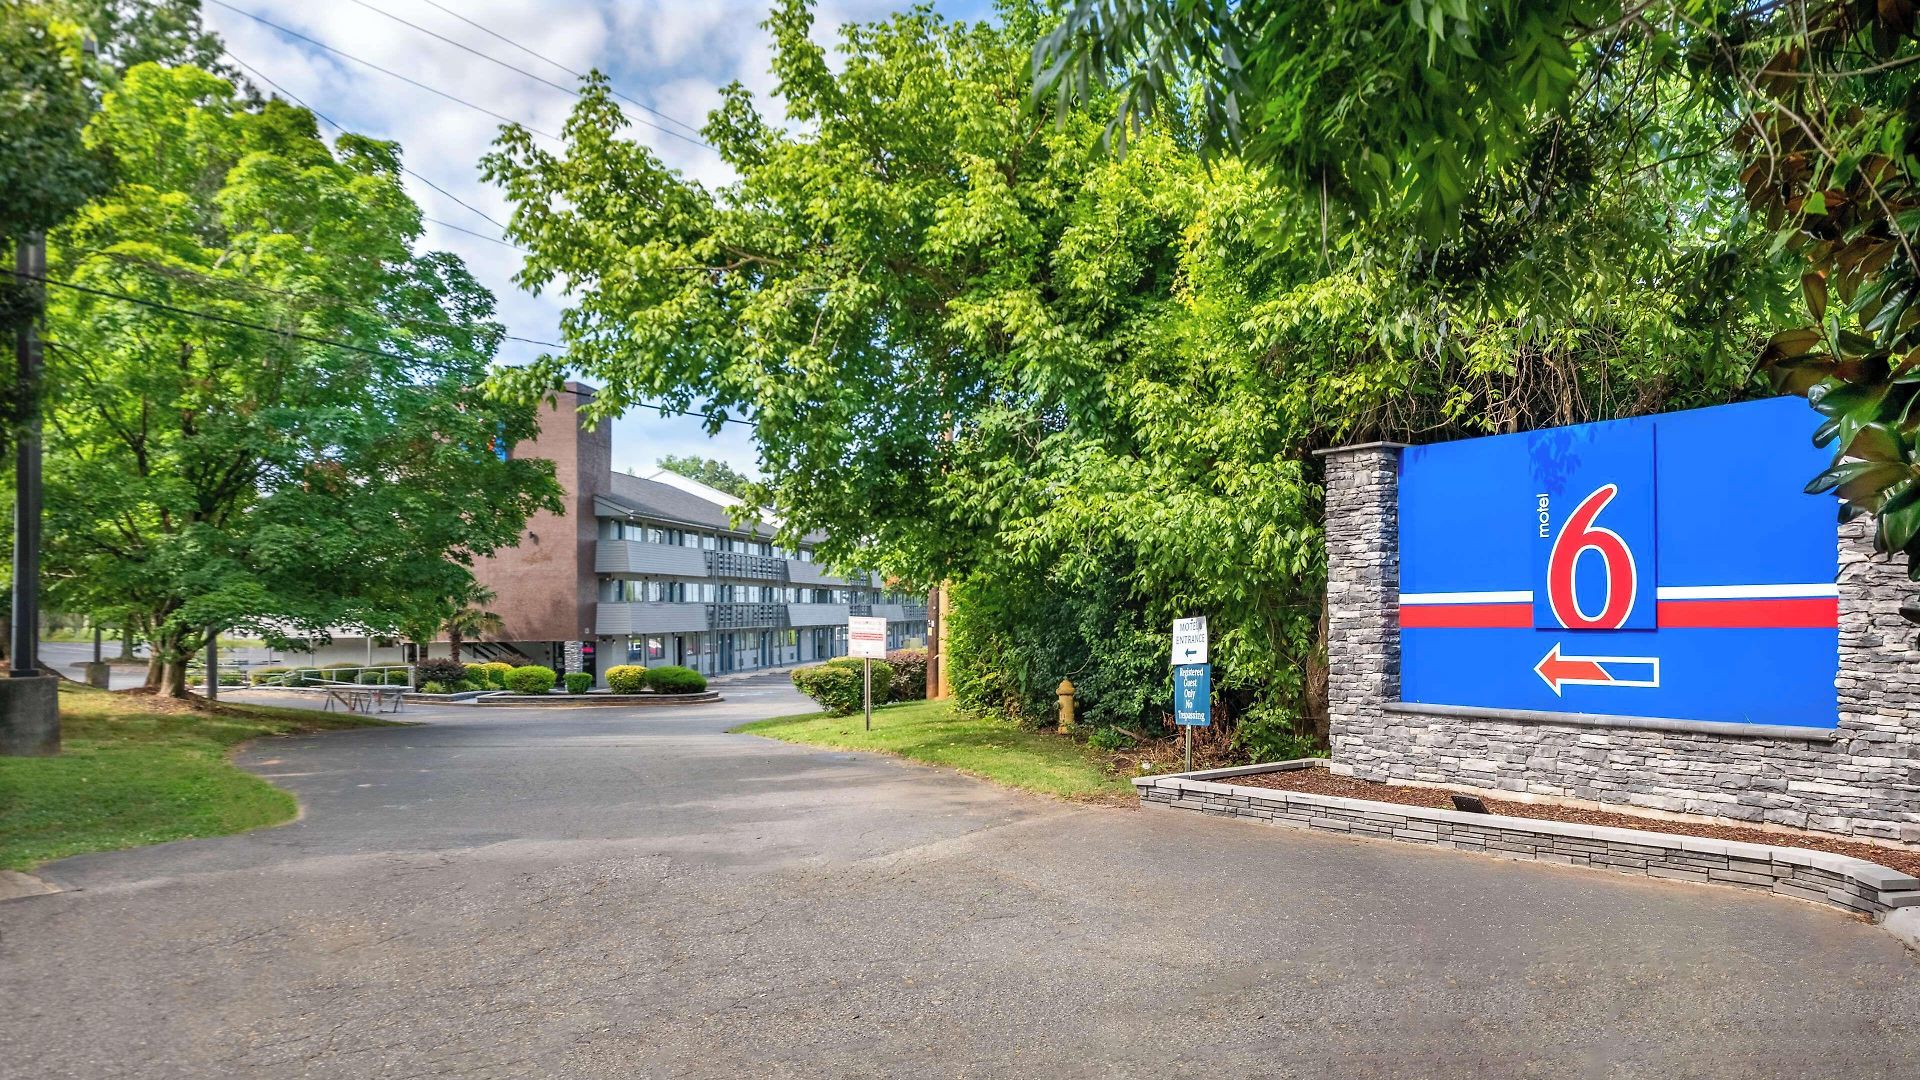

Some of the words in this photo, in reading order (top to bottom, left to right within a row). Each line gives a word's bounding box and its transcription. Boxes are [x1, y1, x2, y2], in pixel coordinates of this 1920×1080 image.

[1536, 493, 1550, 538] motel
[1547, 483, 1638, 629] 6
[1176, 633, 1205, 645] ENTRANCE
[1179, 667, 1204, 680] Registered
[1183, 679, 1198, 687] Guest
[1184, 689, 1196, 699] Only
[1185, 700, 1193, 708] No
[1178, 710, 1205, 721] Trespassing
